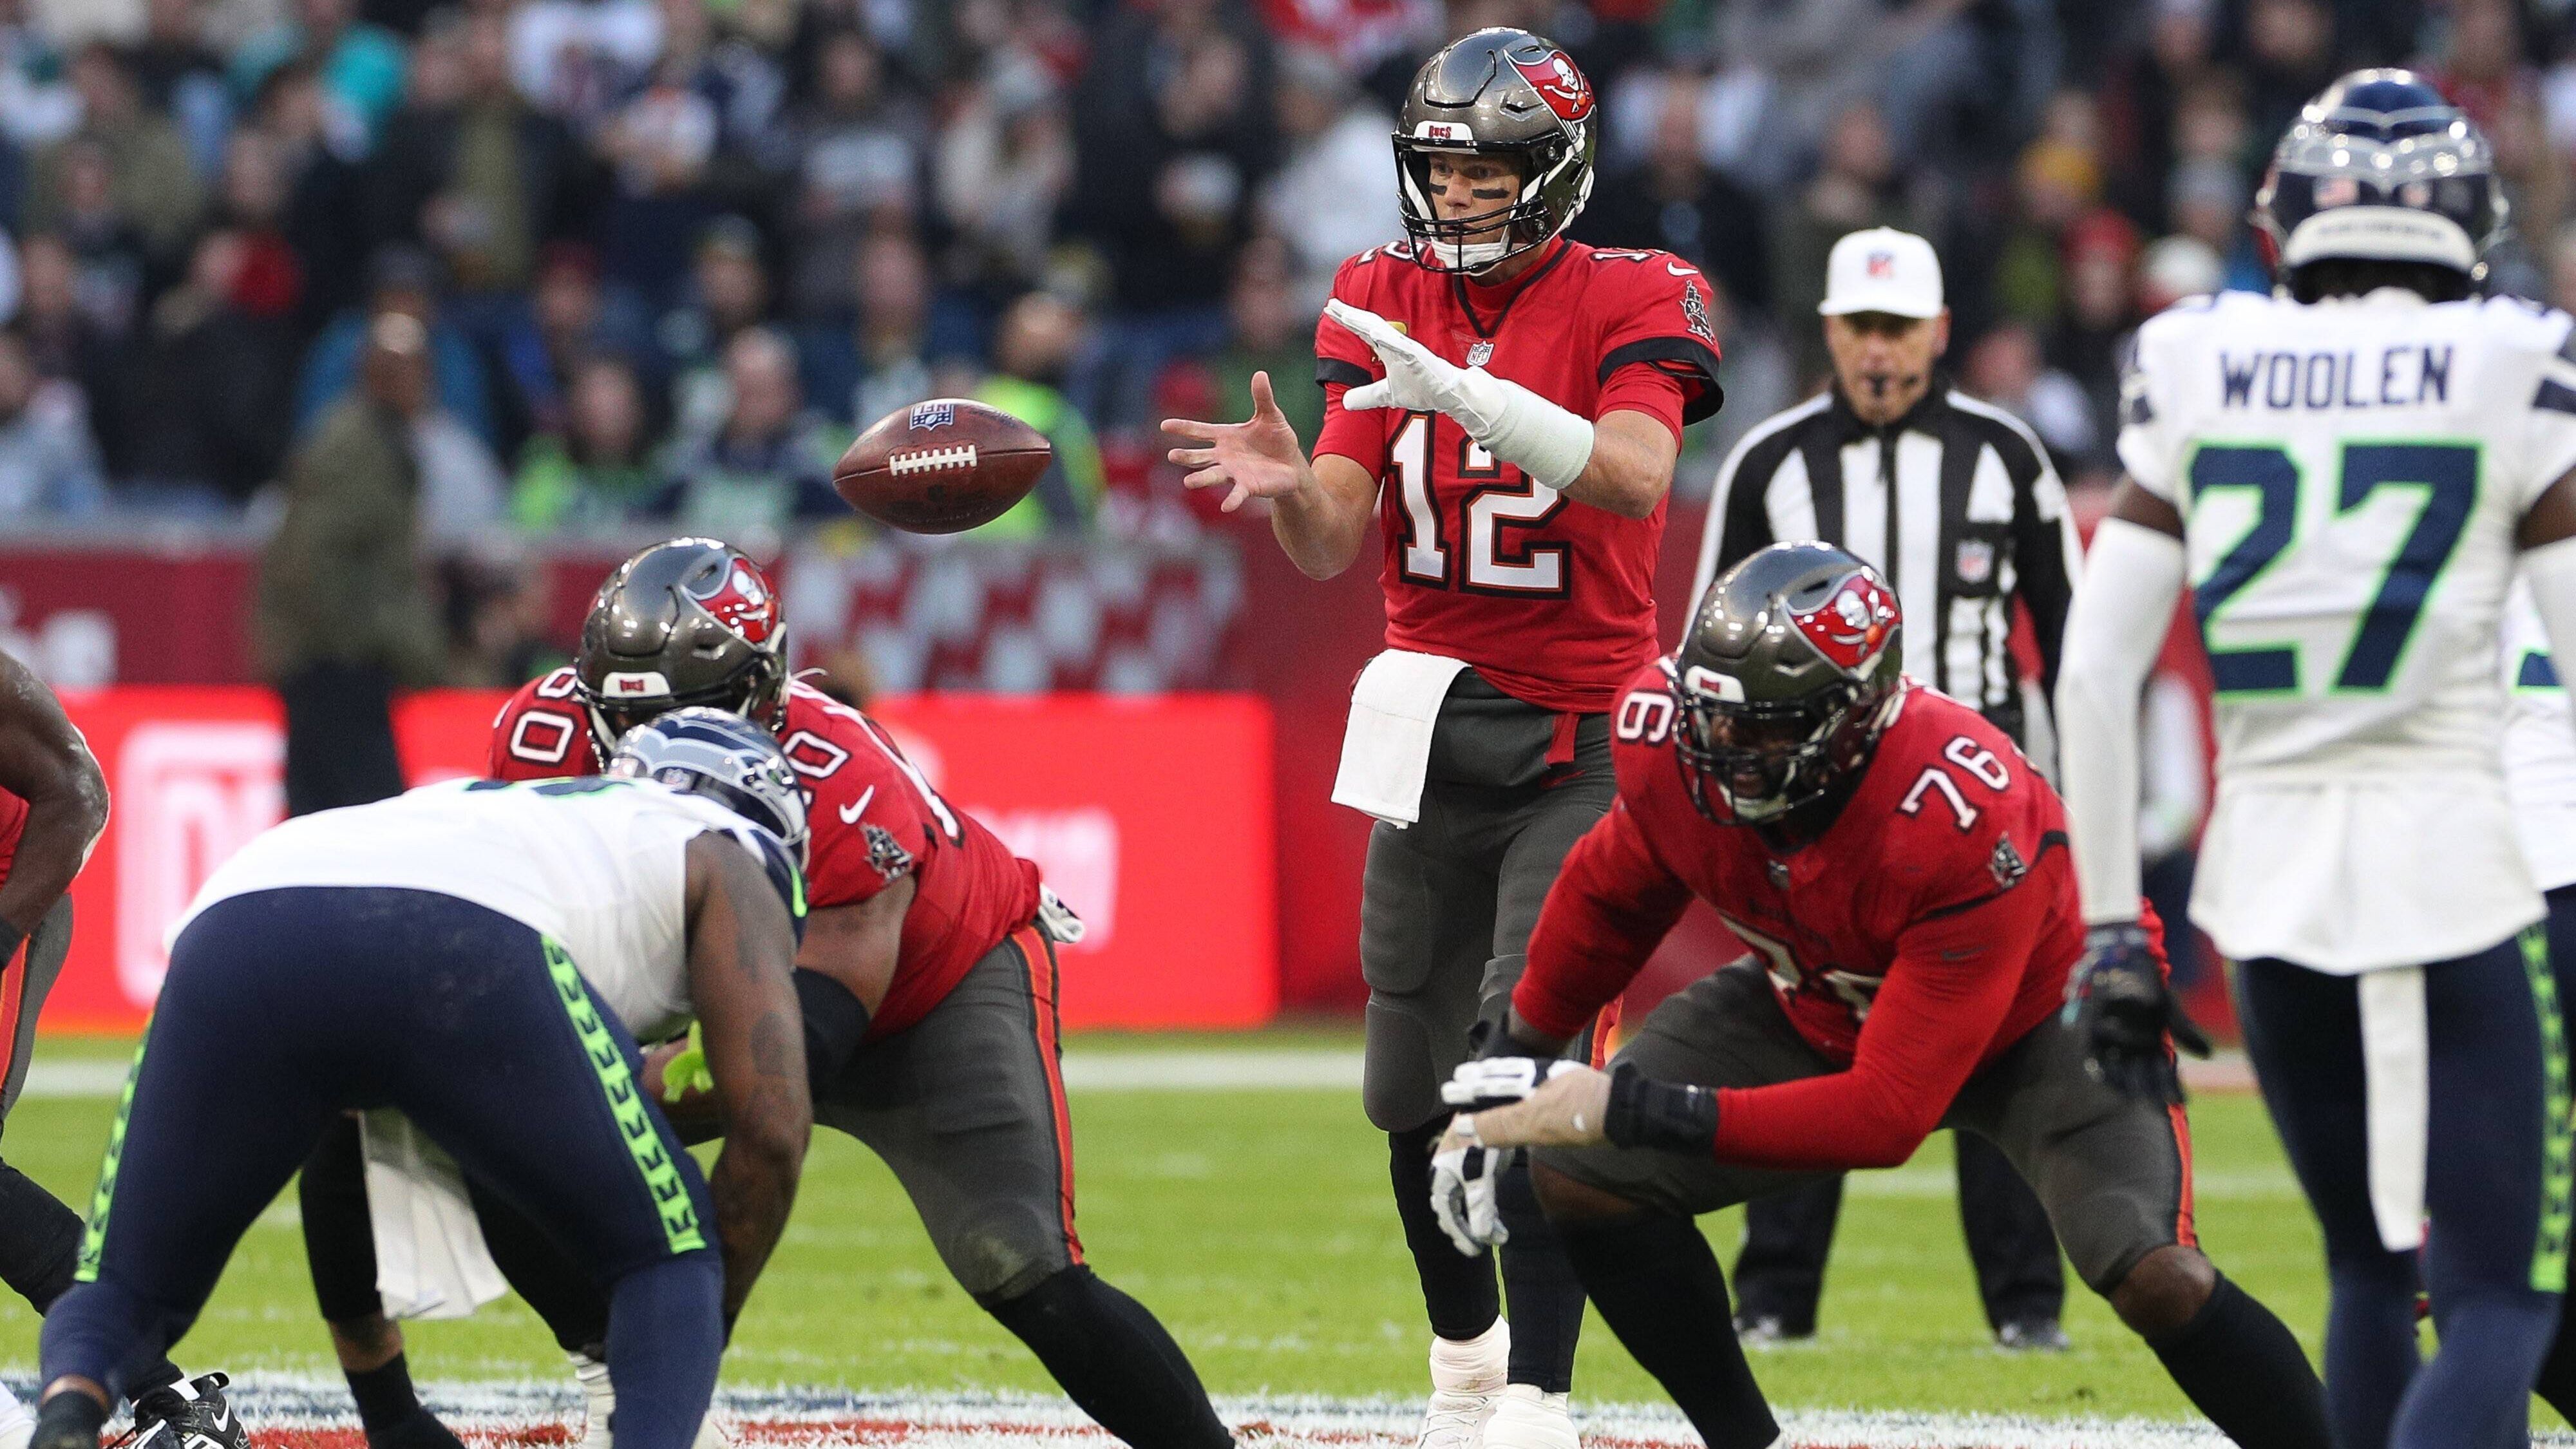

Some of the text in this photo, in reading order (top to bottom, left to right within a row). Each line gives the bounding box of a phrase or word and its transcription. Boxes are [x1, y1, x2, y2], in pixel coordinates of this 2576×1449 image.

[2219, 346, 2452, 408] WOOLEN
[1387, 411, 1569, 598] 12
[2186, 439, 2483, 696] 27
[1898, 733, 2011, 831] 76
